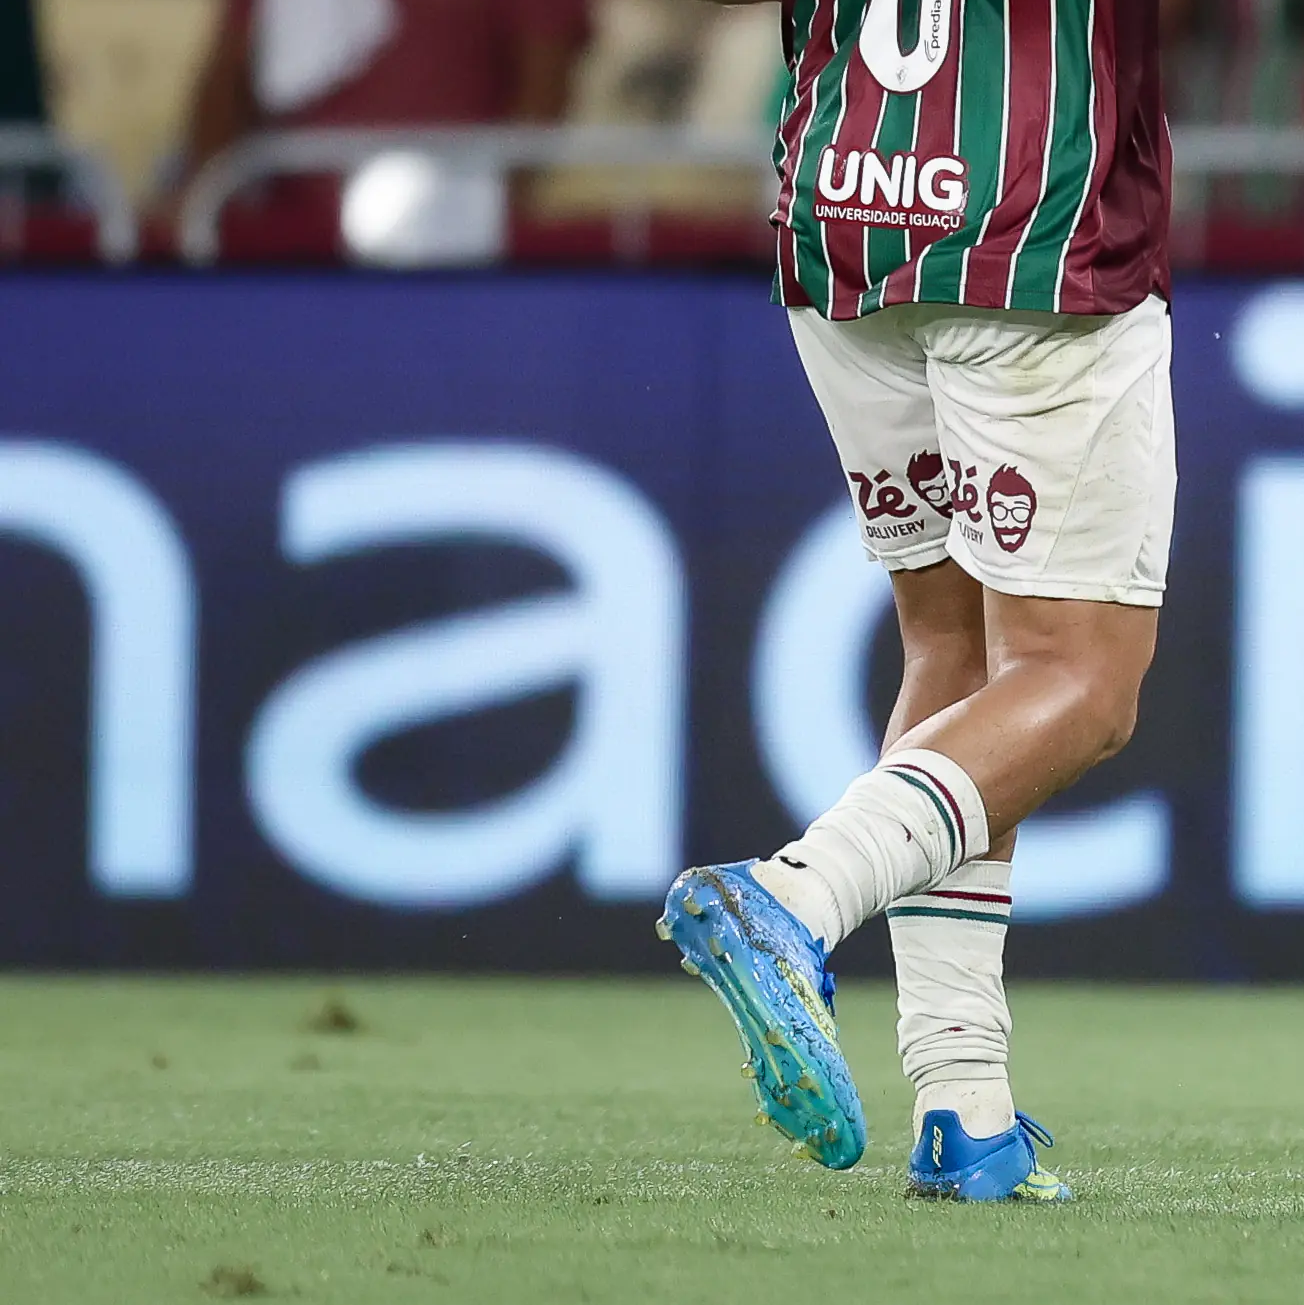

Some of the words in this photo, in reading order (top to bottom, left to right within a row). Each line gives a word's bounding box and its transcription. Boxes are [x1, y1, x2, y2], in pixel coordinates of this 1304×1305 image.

[818, 148, 965, 212] UNIG
[815, 204, 907, 226] UNIVERSIDADE
[909, 213, 961, 231] IGUAÇU
[848, 468, 918, 521] Zé
[865, 519, 926, 540] DELIVERY
